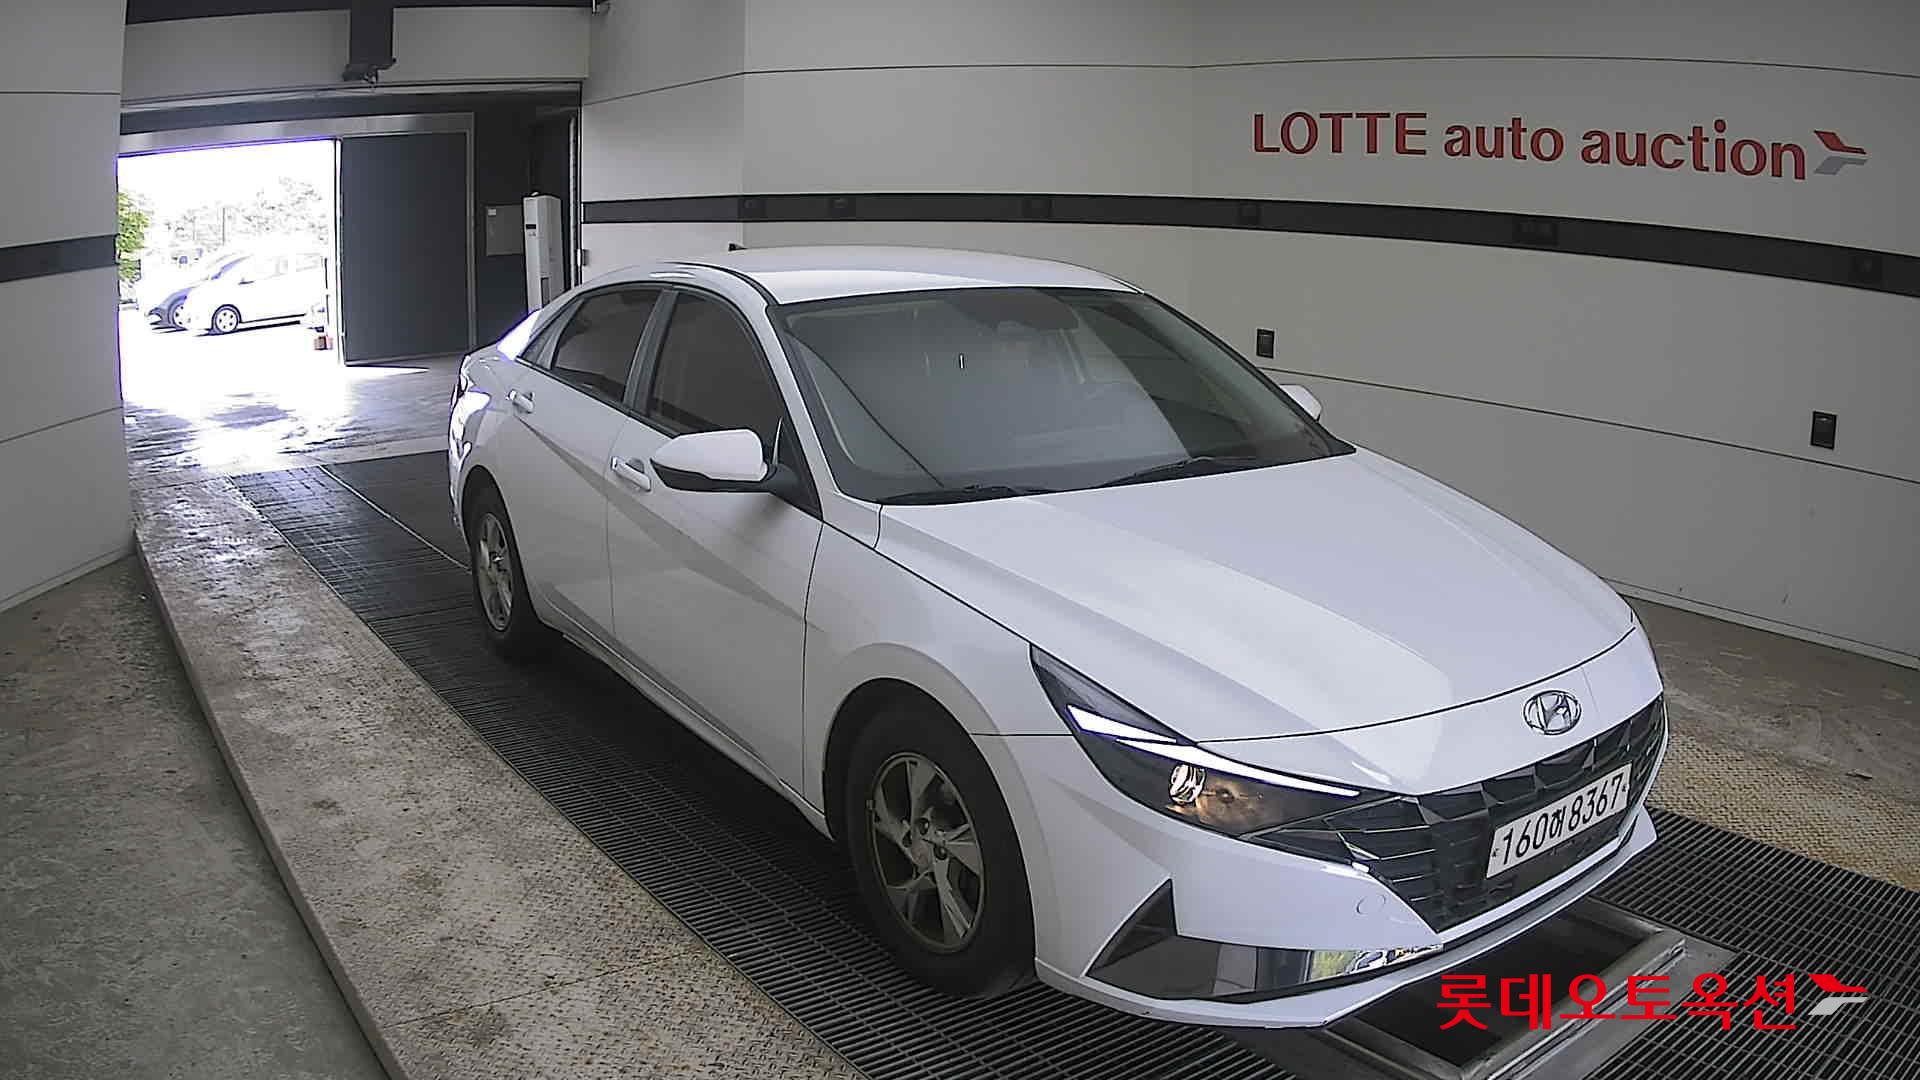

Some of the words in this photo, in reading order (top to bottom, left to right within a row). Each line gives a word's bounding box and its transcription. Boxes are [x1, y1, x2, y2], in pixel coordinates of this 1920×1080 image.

[1253, 111, 1428, 156] LOTTE
[1443, 117, 1565, 162] auto
[1581, 119, 1807, 181] auction
